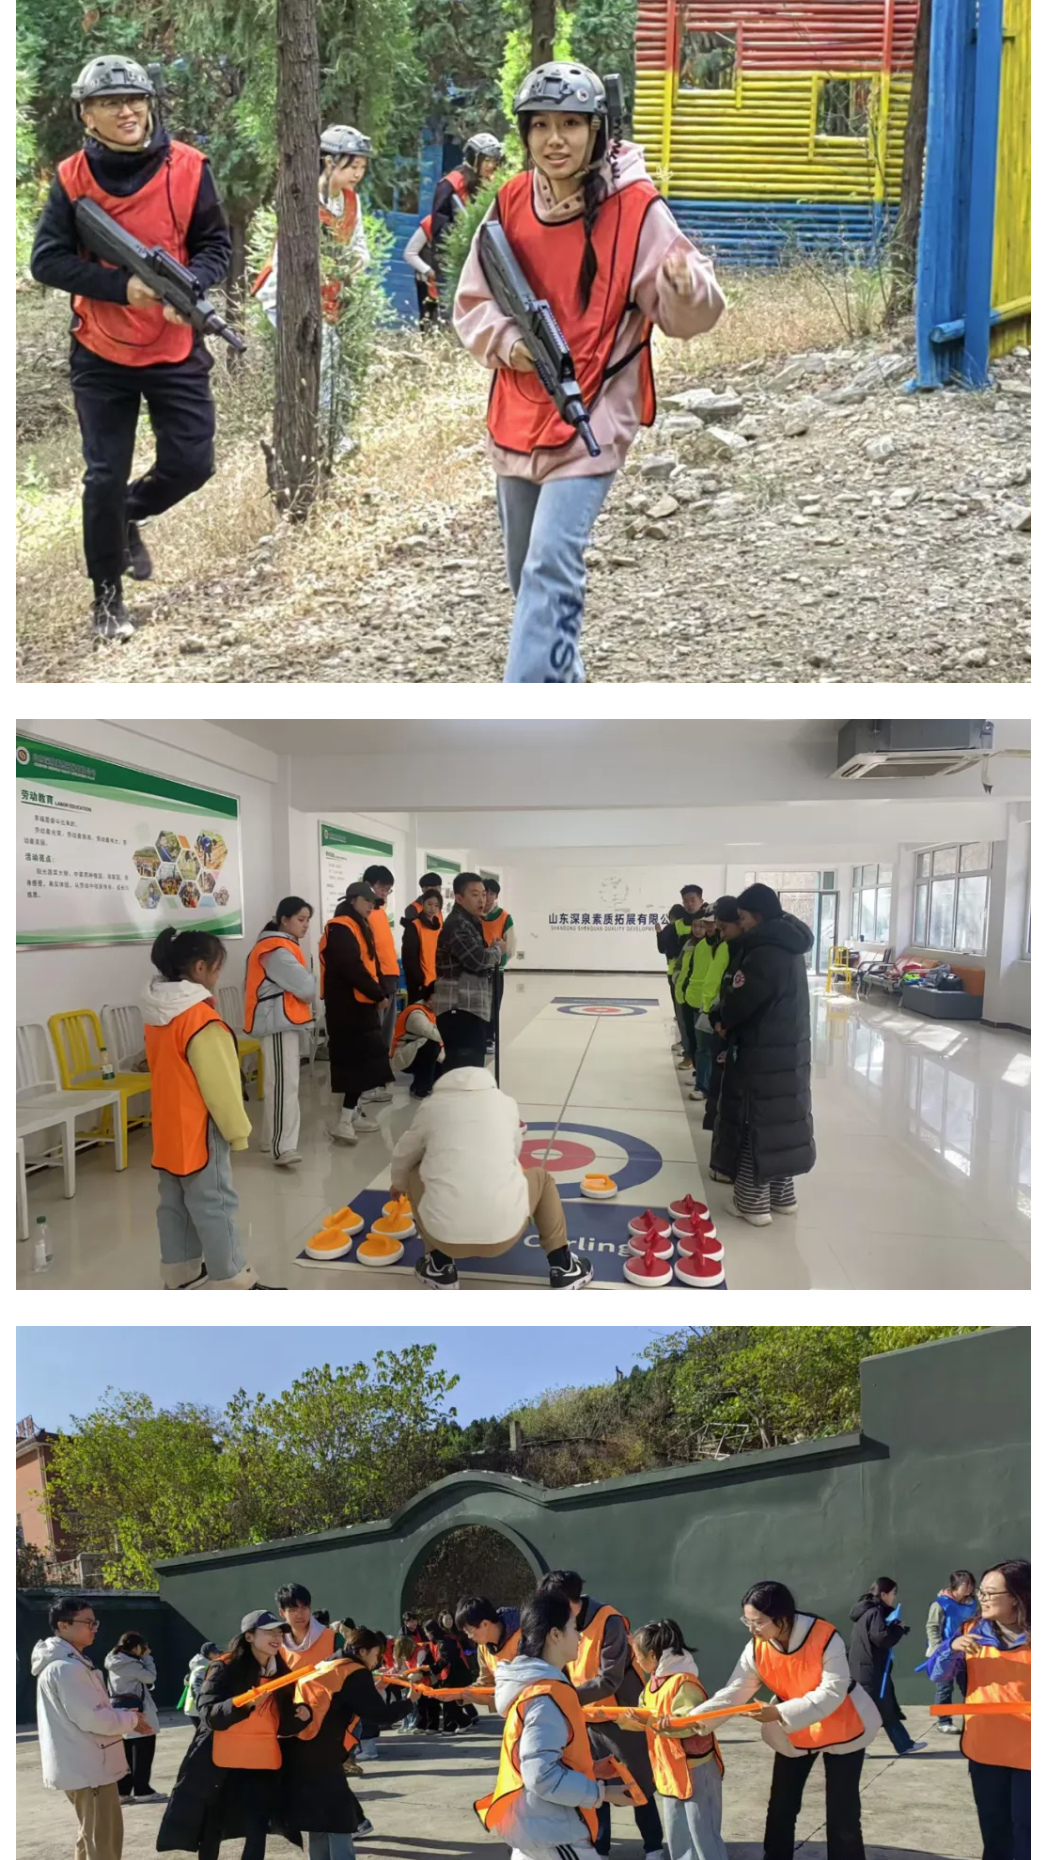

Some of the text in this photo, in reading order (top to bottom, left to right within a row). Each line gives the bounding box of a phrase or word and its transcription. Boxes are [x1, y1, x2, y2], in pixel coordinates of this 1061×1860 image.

[21, 789, 54, 805] 劳动教育
[523, 1234, 632, 1257] Crling
